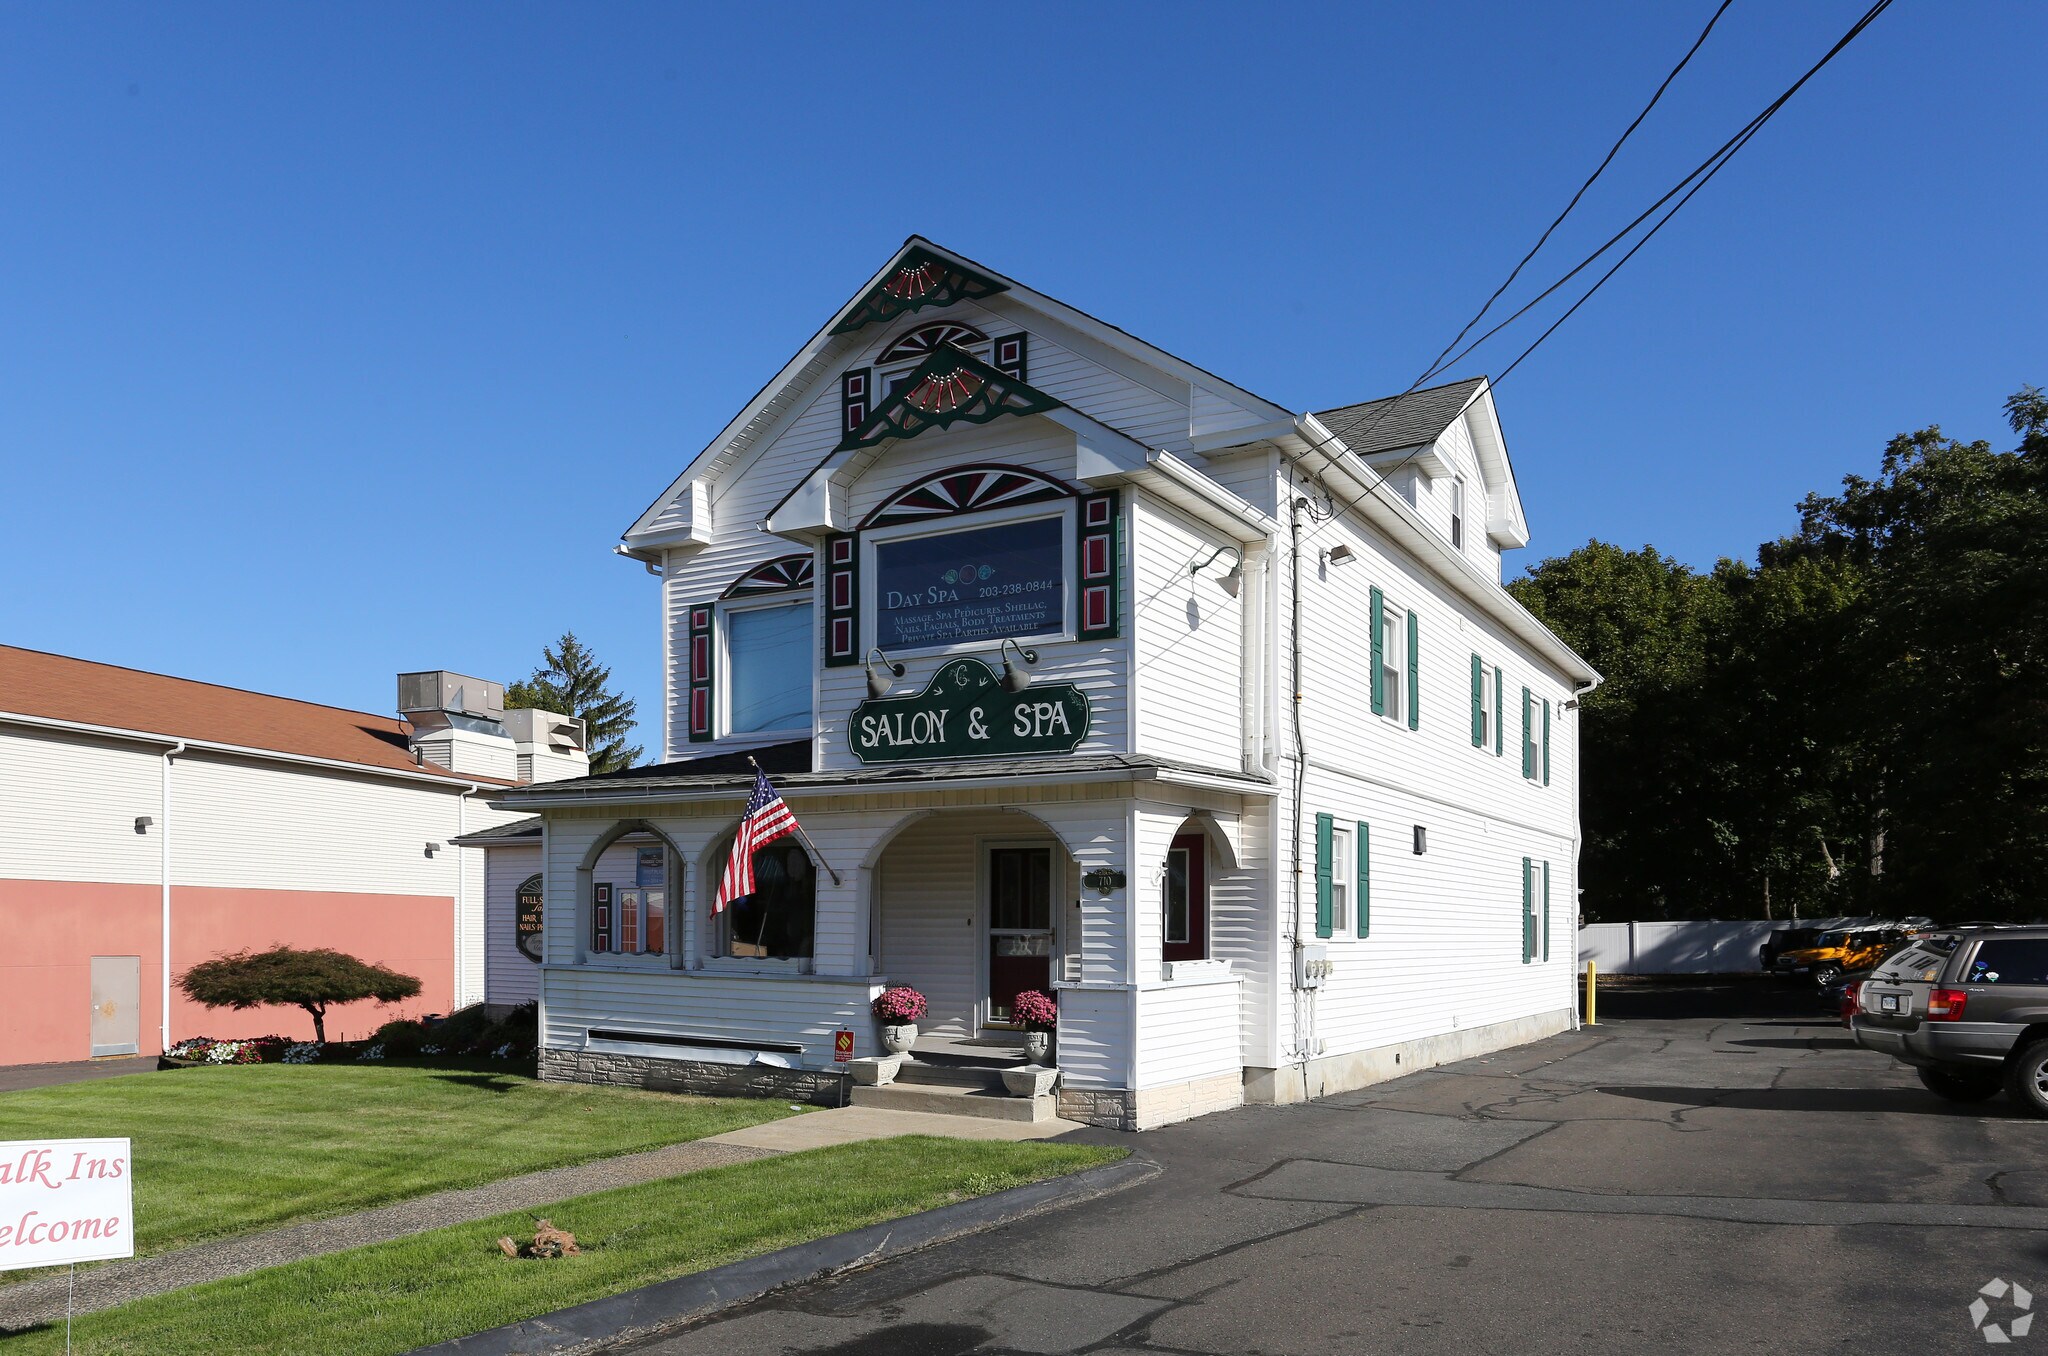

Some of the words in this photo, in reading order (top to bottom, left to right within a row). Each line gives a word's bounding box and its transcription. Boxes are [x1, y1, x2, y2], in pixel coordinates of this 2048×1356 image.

[887, 591, 922, 609] DAY
[927, 586, 959, 605] SPA
[979, 580, 1053, 598] 203-238-0844
[936, 610, 952, 620] SPA
[962, 617, 986, 627] BODY
[988, 611, 1046, 623] TREATMENTS
[902, 633, 935, 643] PRIVATE
[936, 629, 952, 640] SPA
[955, 627, 989, 638] PARTIES
[991, 622, 1039, 634] AVAILABLE
[860, 709, 950, 748] SALON
[967, 706, 991, 740] &
[1013, 701, 1072, 738] SPA
[1099, 875, 1112, 886] 710
[522, 914, 537, 923] HAIR
[65, 1152, 125, 1180] Ins
